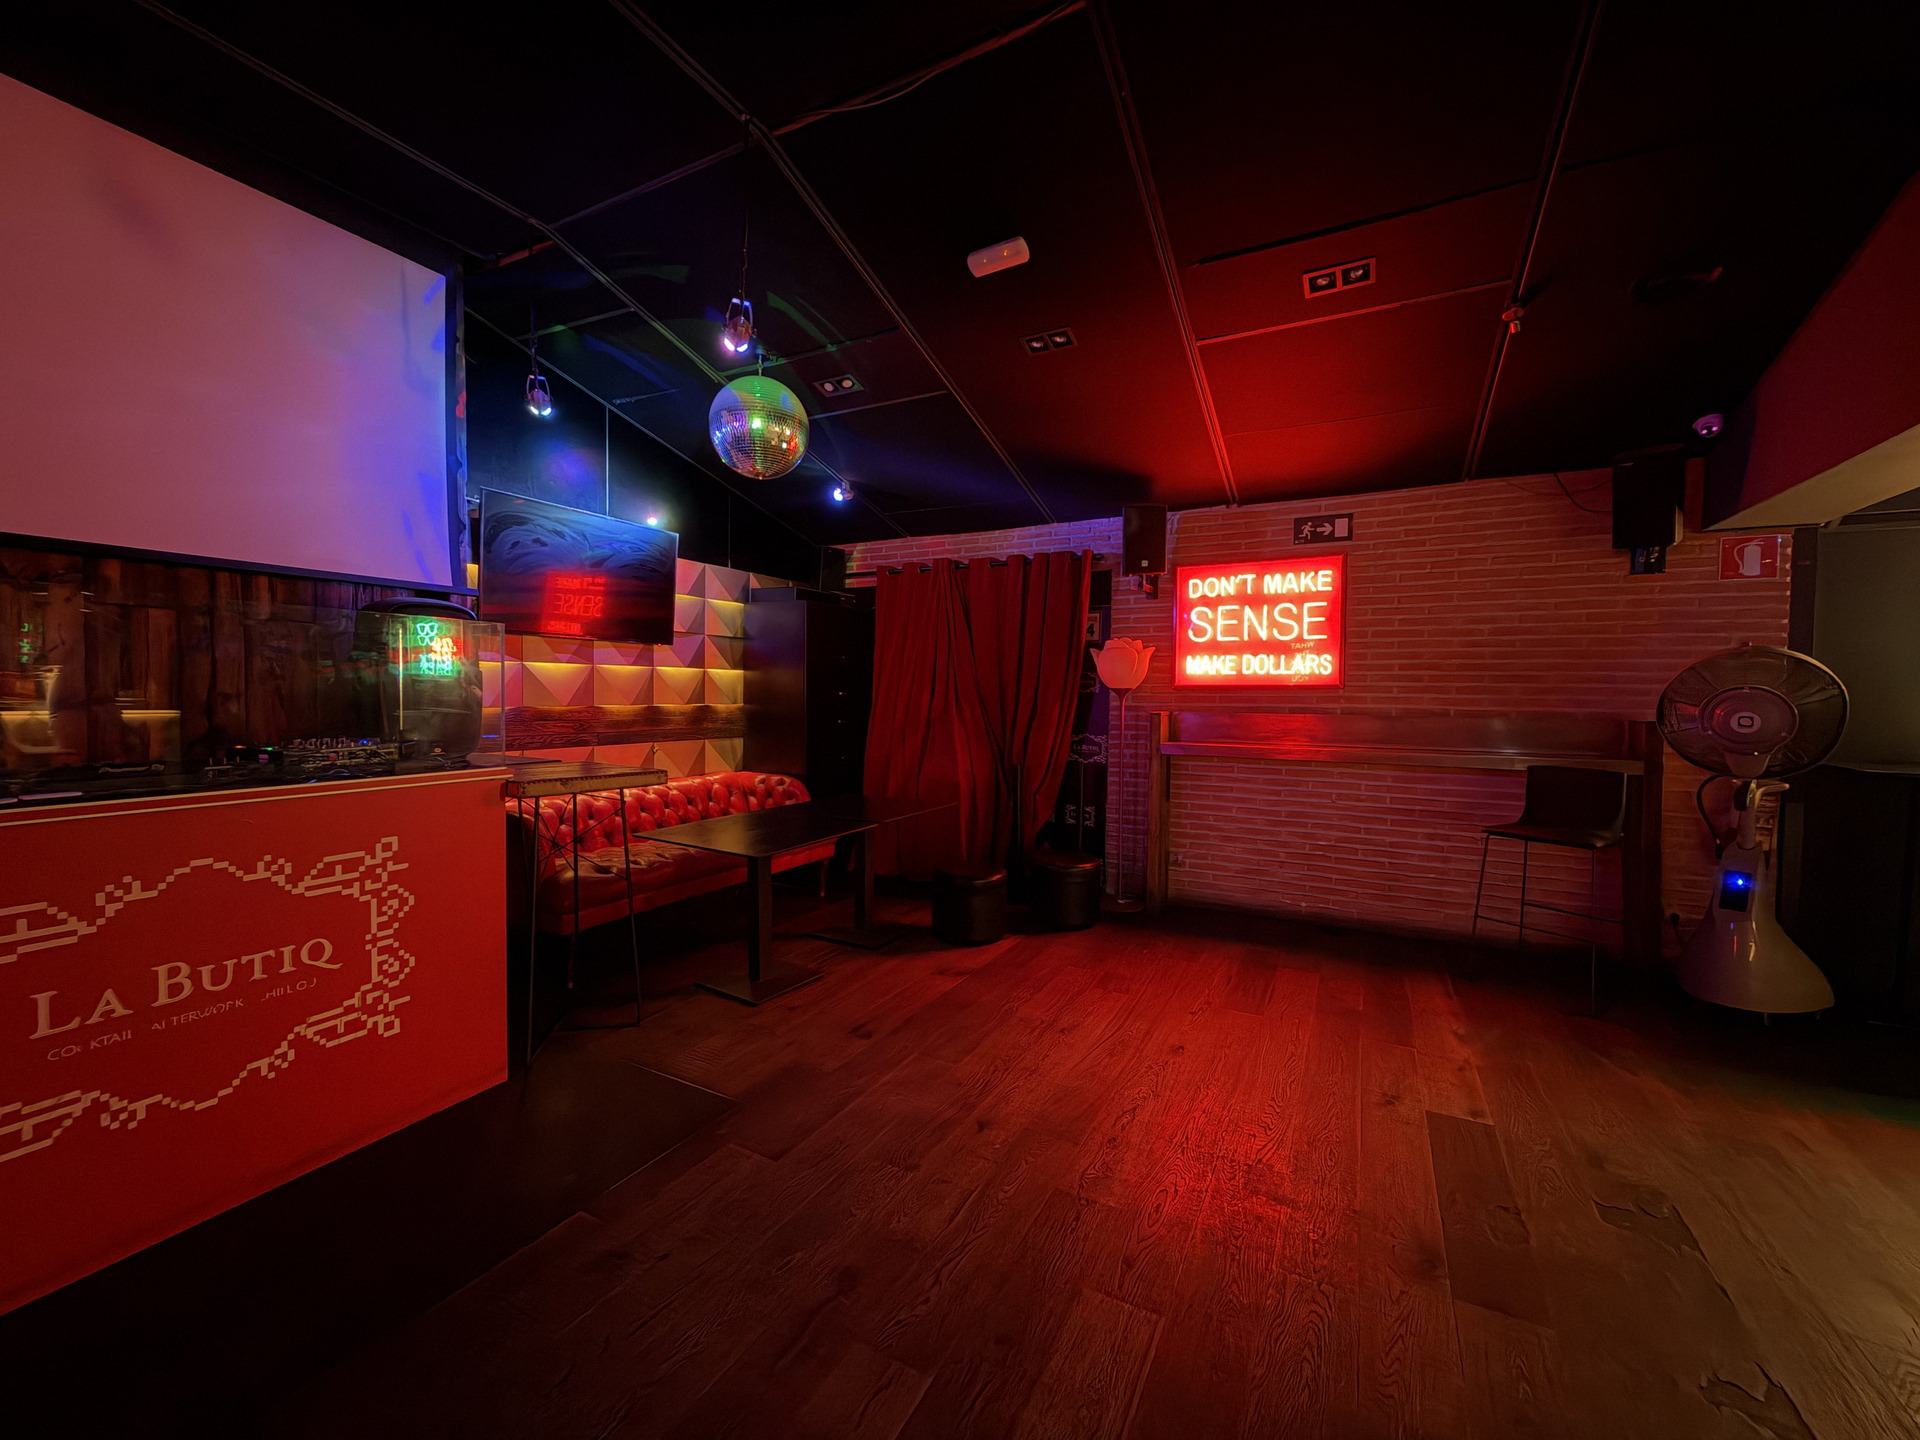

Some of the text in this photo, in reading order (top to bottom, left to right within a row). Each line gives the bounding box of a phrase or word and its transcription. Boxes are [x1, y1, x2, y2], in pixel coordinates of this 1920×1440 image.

[1188, 570, 1333, 598] DON'T MAKE
[1187, 601, 1328, 642] SENSE
[1185, 654, 1333, 675] MAKE DOLLARS
[28, 938, 344, 1040] LA BUTIQ
